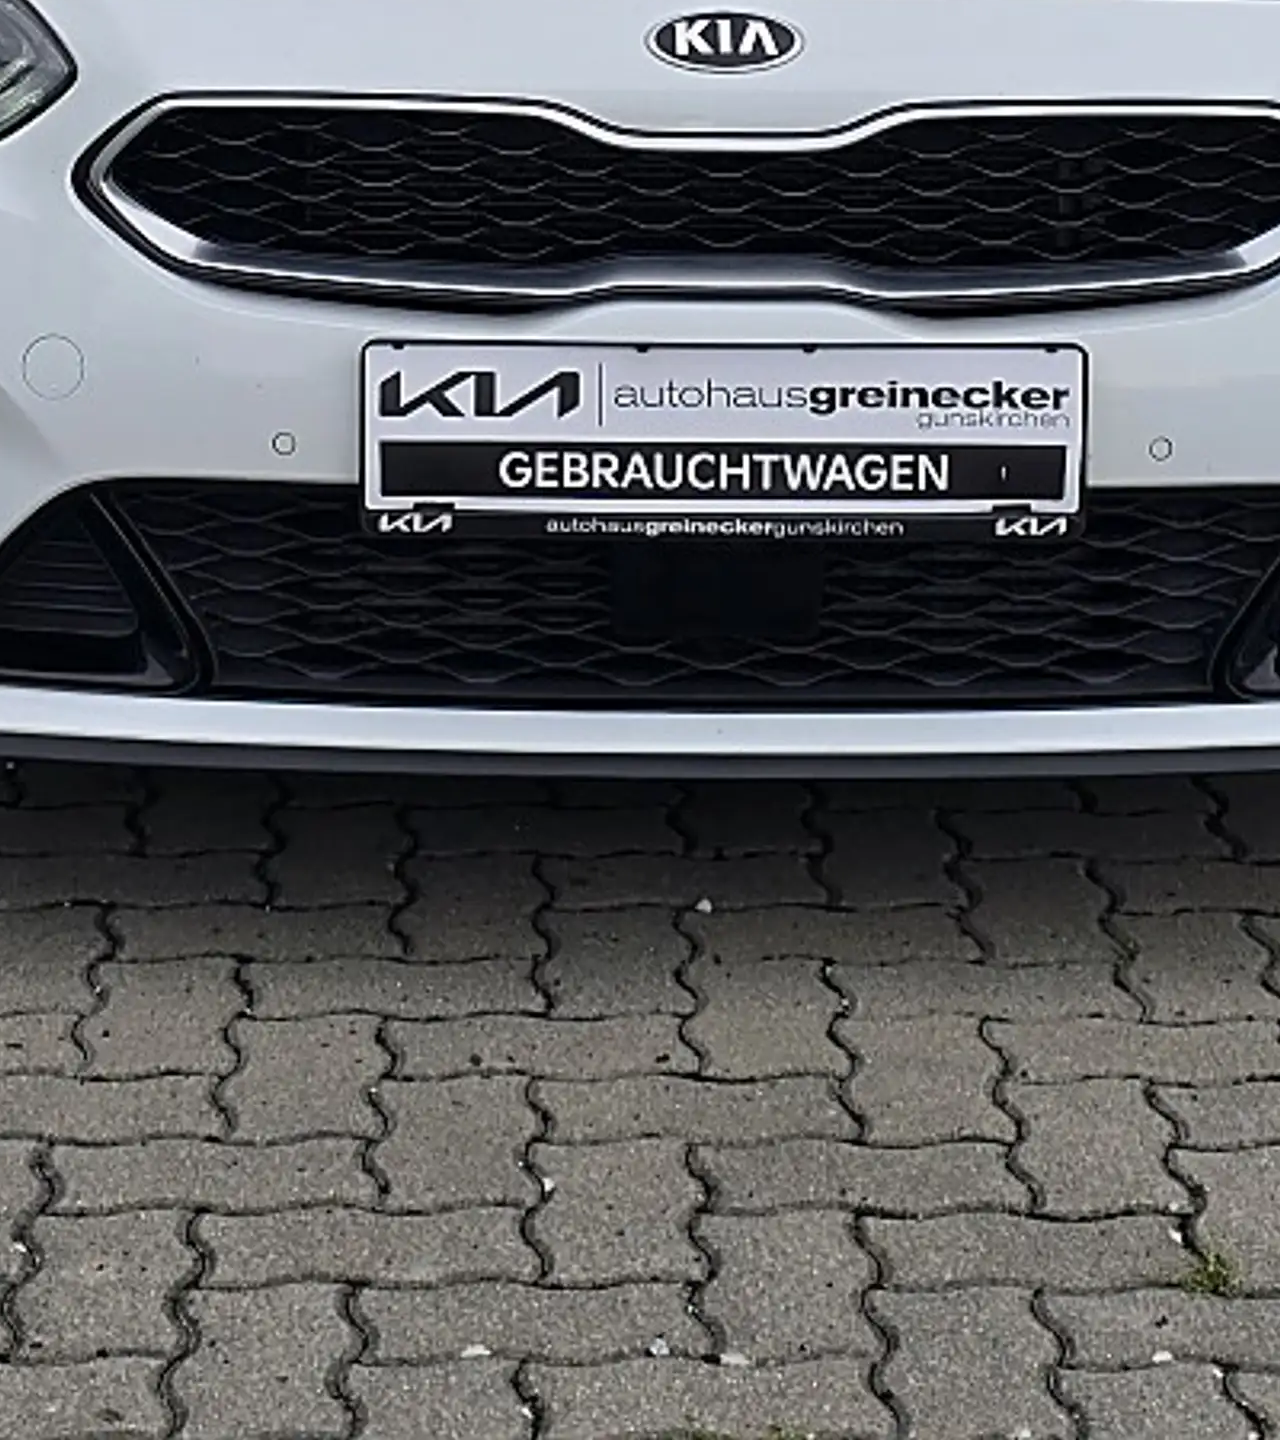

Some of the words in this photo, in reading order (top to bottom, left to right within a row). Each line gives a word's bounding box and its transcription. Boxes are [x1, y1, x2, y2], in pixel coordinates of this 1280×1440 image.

[673, 18, 779, 56] KIA
[378, 369, 581, 418] KIA
[915, 408, 1071, 430] gunskirchen
[498, 450, 950, 491] GEBRAUCHTWAGEN
[377, 512, 454, 534] KIA
[994, 516, 1068, 537] KIA
